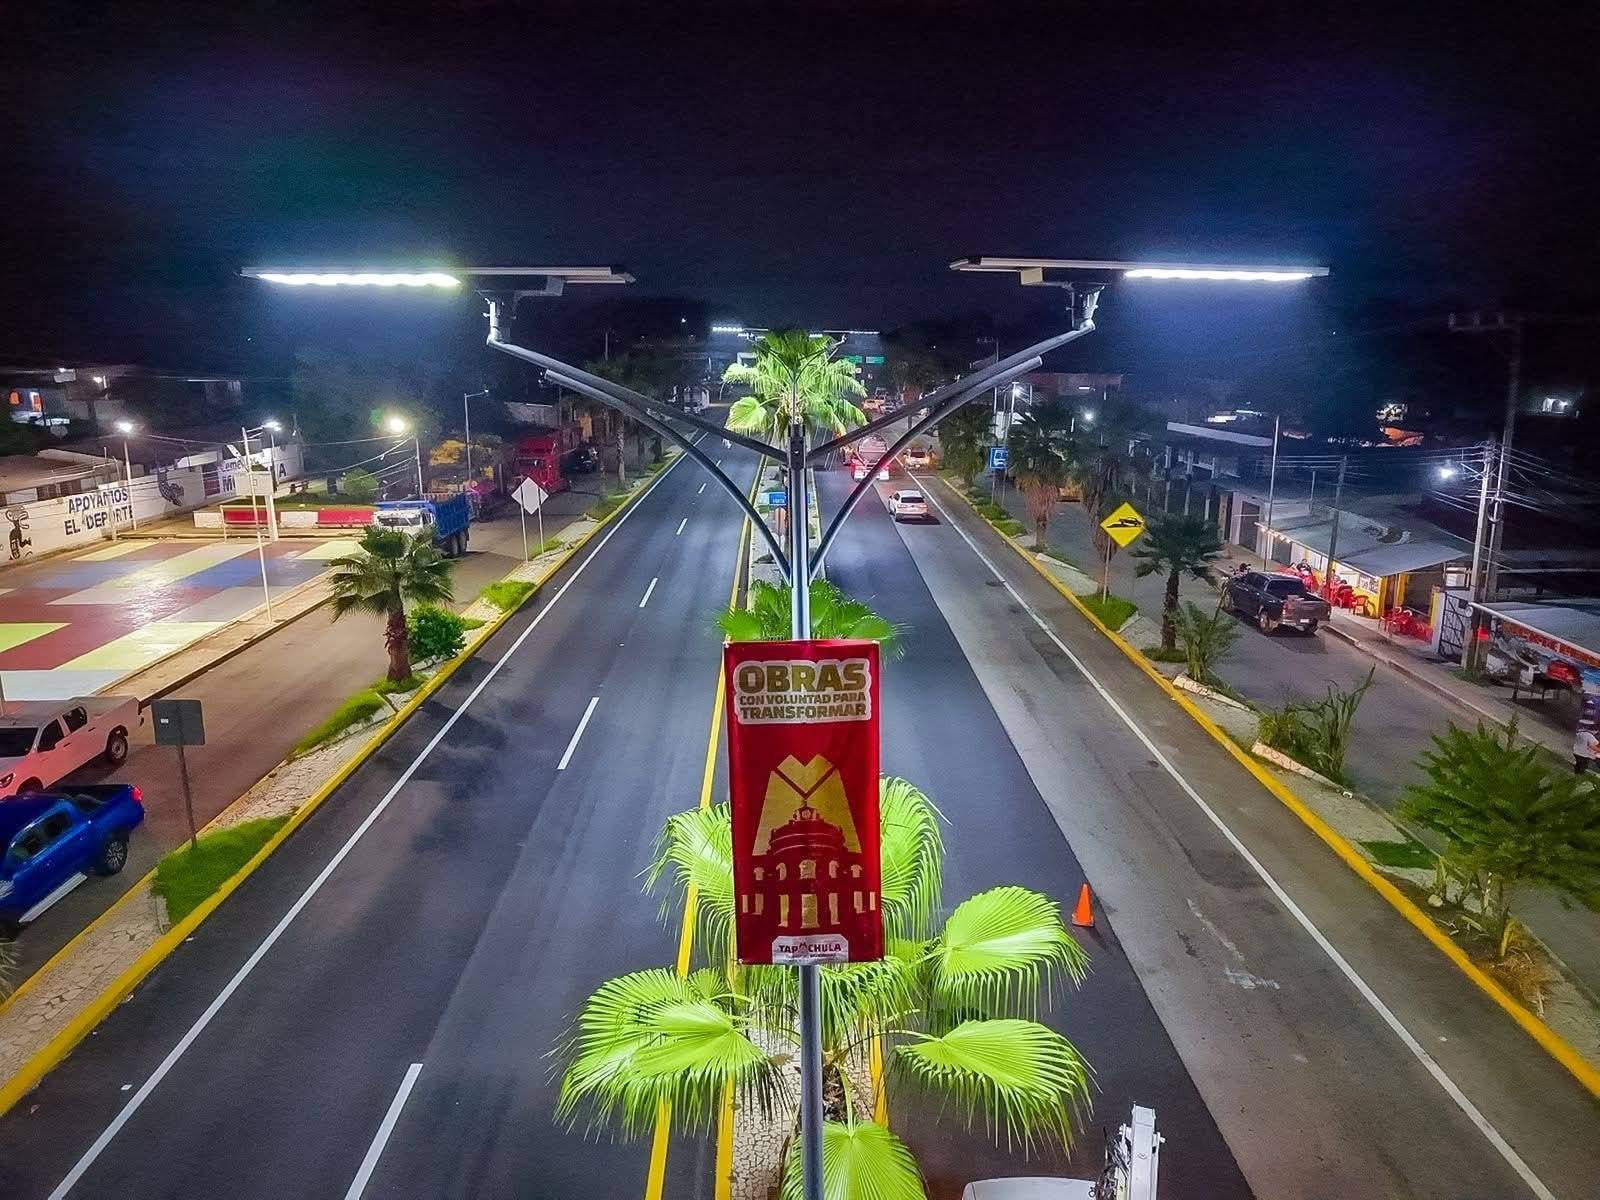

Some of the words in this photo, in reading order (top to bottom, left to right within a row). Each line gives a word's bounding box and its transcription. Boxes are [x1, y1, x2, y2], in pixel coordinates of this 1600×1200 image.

[64, 519, 81, 536] EL
[738, 663, 867, 694] OBRAS
[739, 695, 764, 706] CON
[767, 693, 832, 704] VOLUNTAD
[833, 691, 866, 702] PARA
[739, 702, 866, 720] TRANSFORMAR
